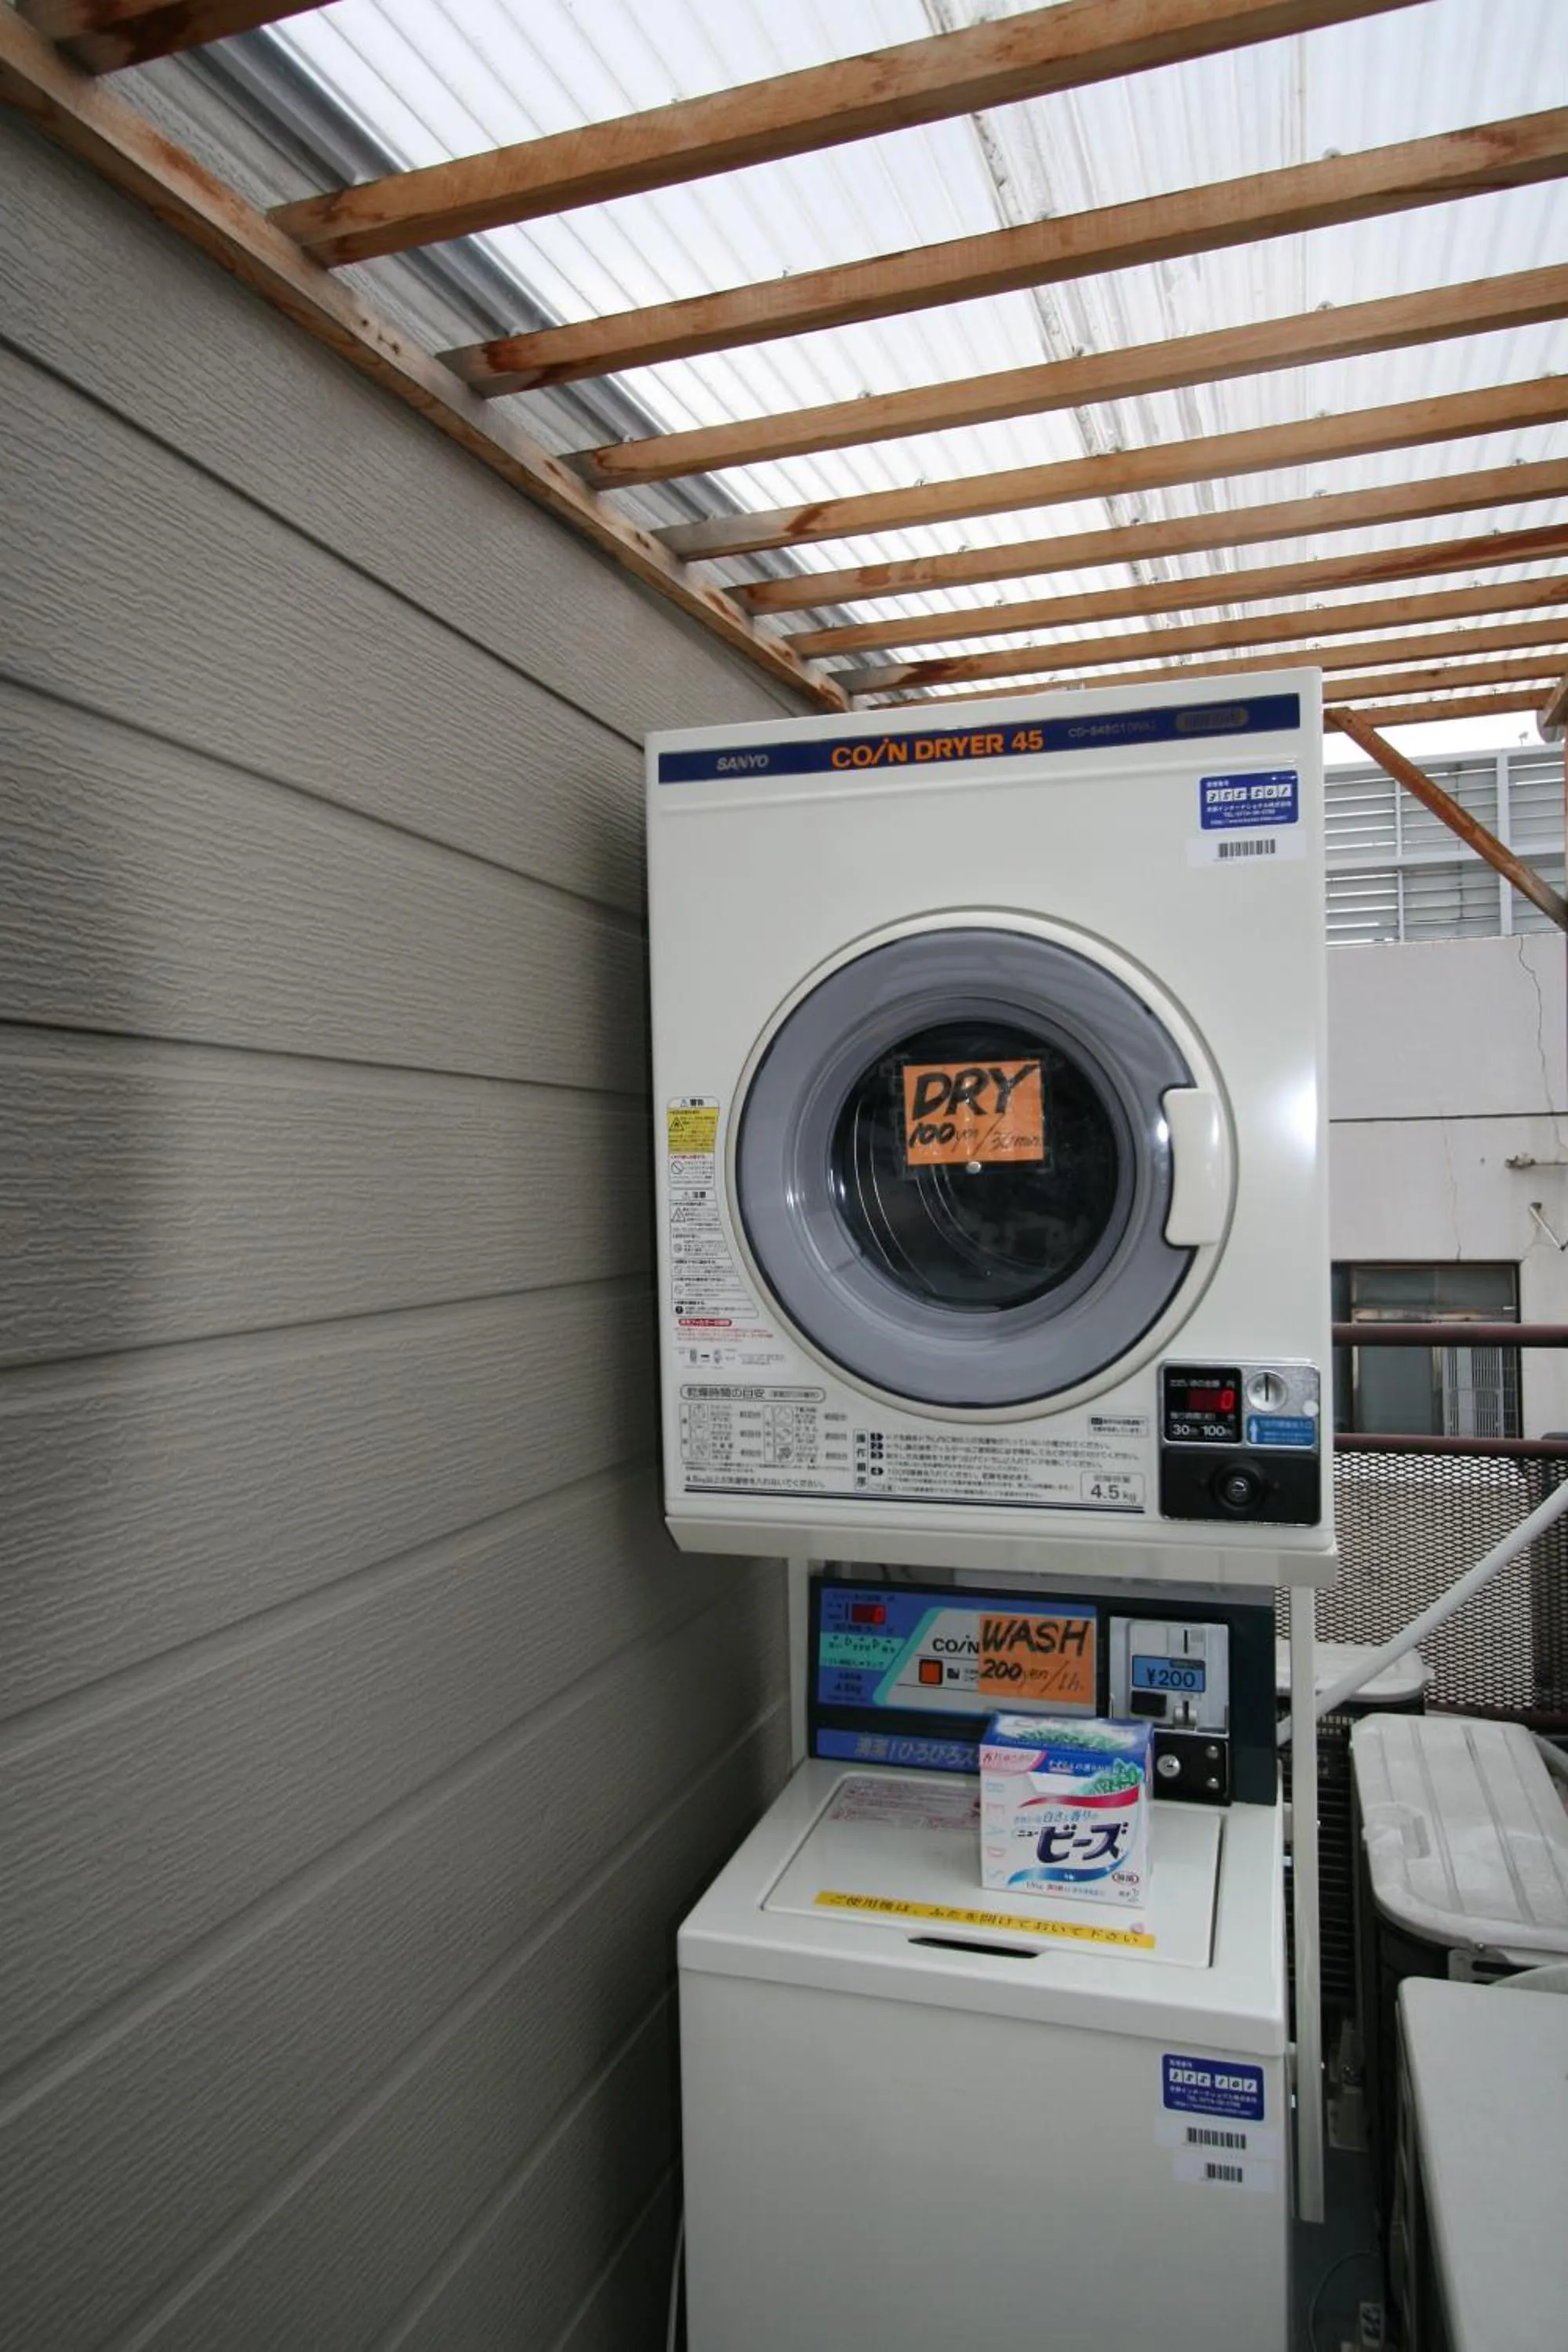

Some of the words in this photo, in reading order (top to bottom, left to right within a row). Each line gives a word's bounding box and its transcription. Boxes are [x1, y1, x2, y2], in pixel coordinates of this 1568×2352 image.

[914, 732, 1004, 761] DRYER
[1011, 729, 1045, 752] 45
[716, 754, 769, 771] SANYO
[913, 1063, 1039, 1120] DRY
[981, 1620, 1091, 1657] WASH
[1146, 1668, 1196, 1688] ¥200
[1036, 1822, 1129, 1864] ビーズ
